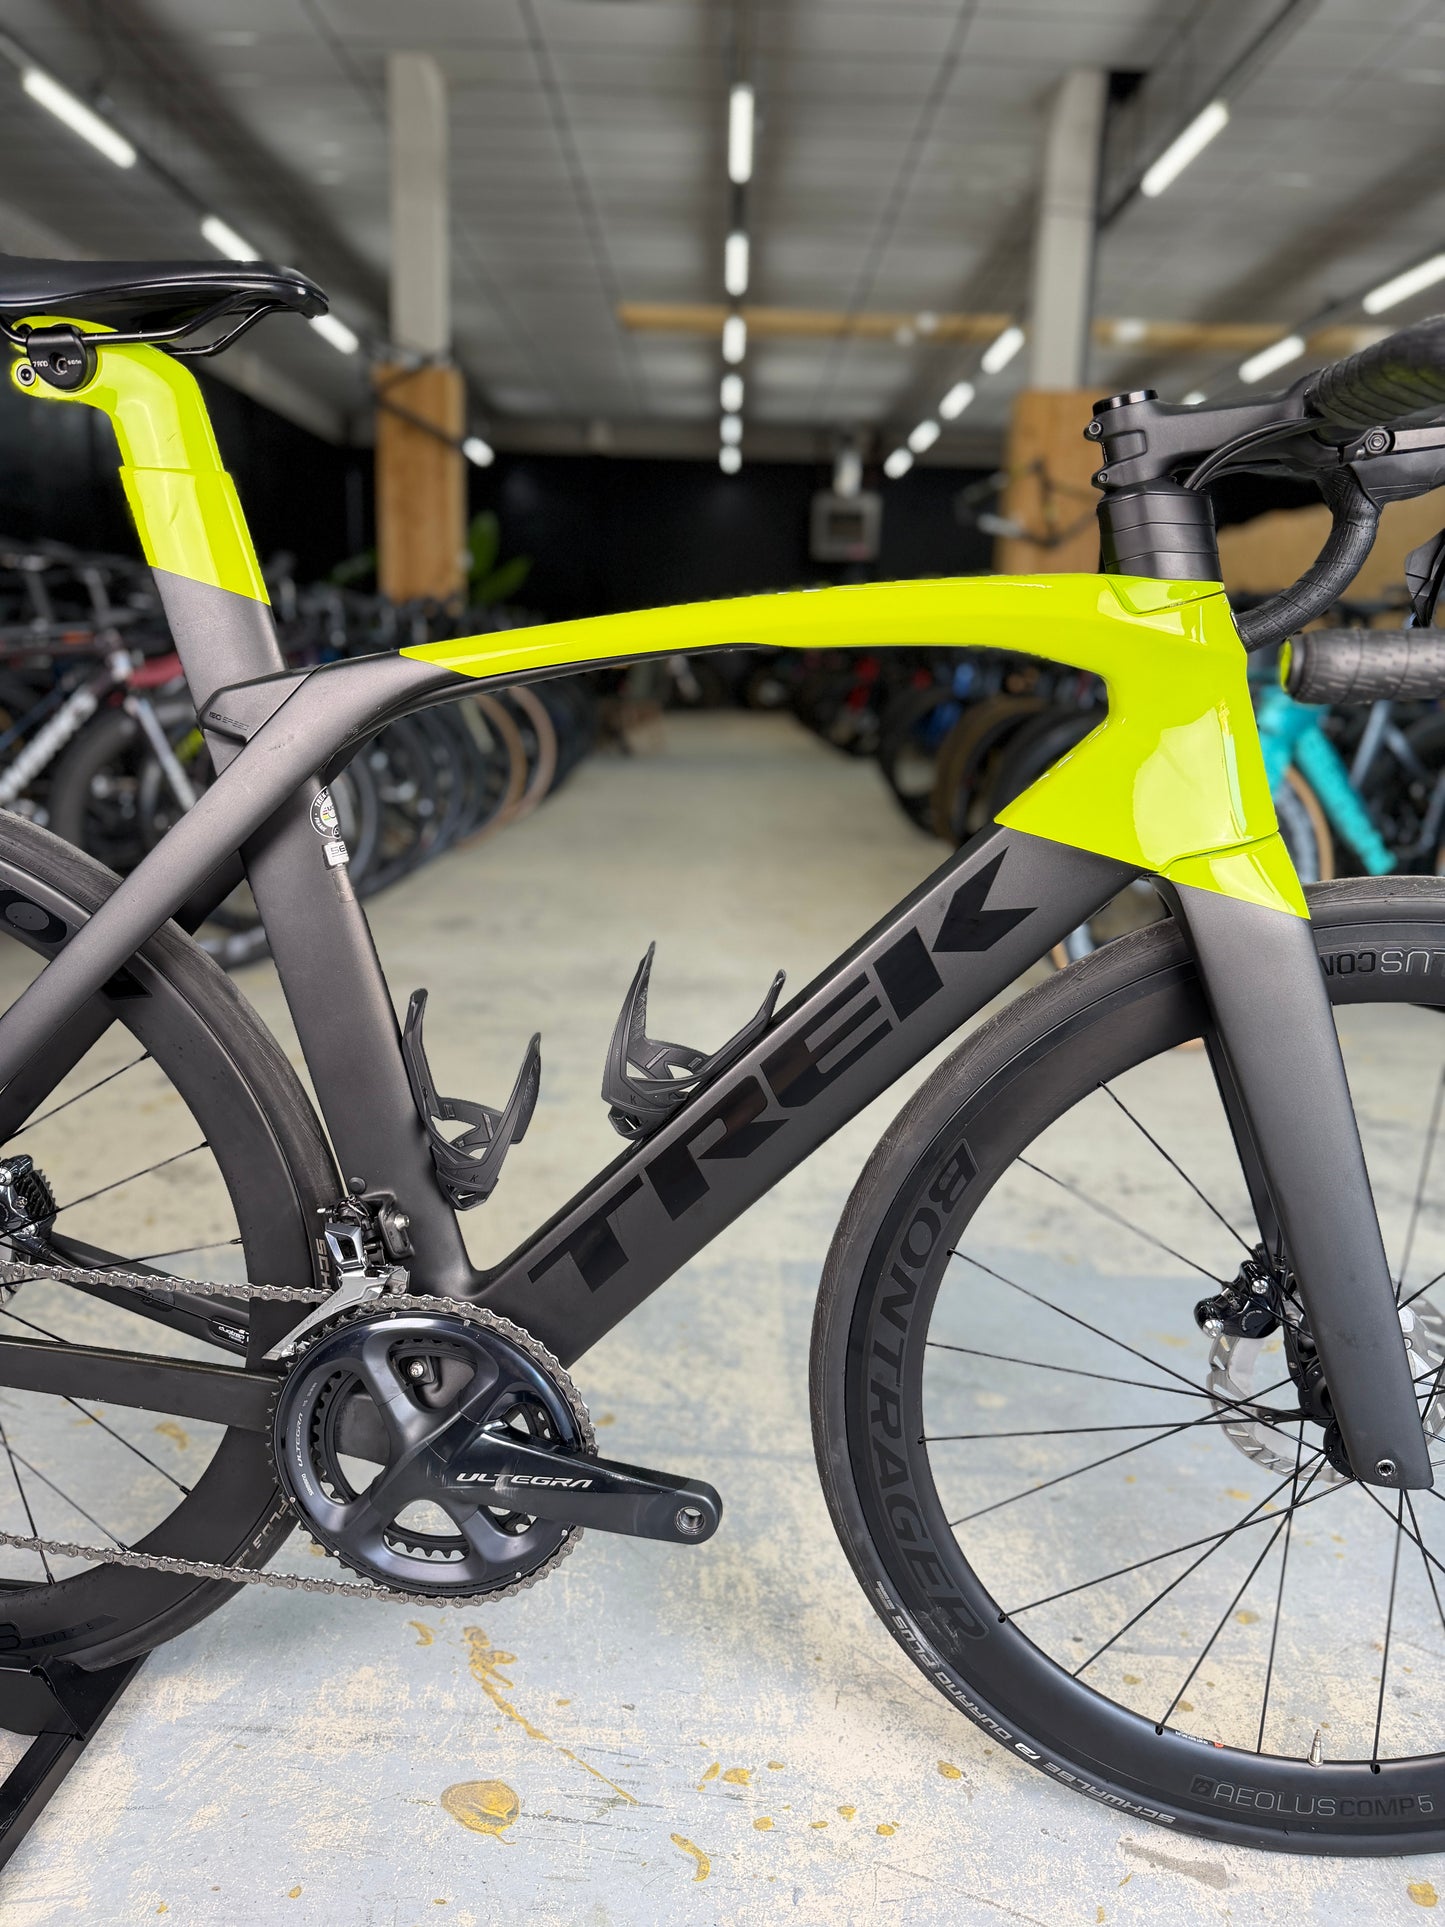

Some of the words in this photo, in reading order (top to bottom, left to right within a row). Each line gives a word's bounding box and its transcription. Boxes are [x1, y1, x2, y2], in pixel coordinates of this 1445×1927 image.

[526, 846, 1040, 1294] TREK
[869, 1140, 986, 1640] BONTRAGER
[295, 1411, 304, 1468] ULTEGRA
[456, 1472, 593, 1489] ULTEGRA
[892, 1614, 942, 1668] PLUS
[935, 1671, 1014, 1741] DURANO
[1042, 1761, 1177, 1825] SCHWALBE
[1213, 1783, 1337, 1817] AEOLUS
